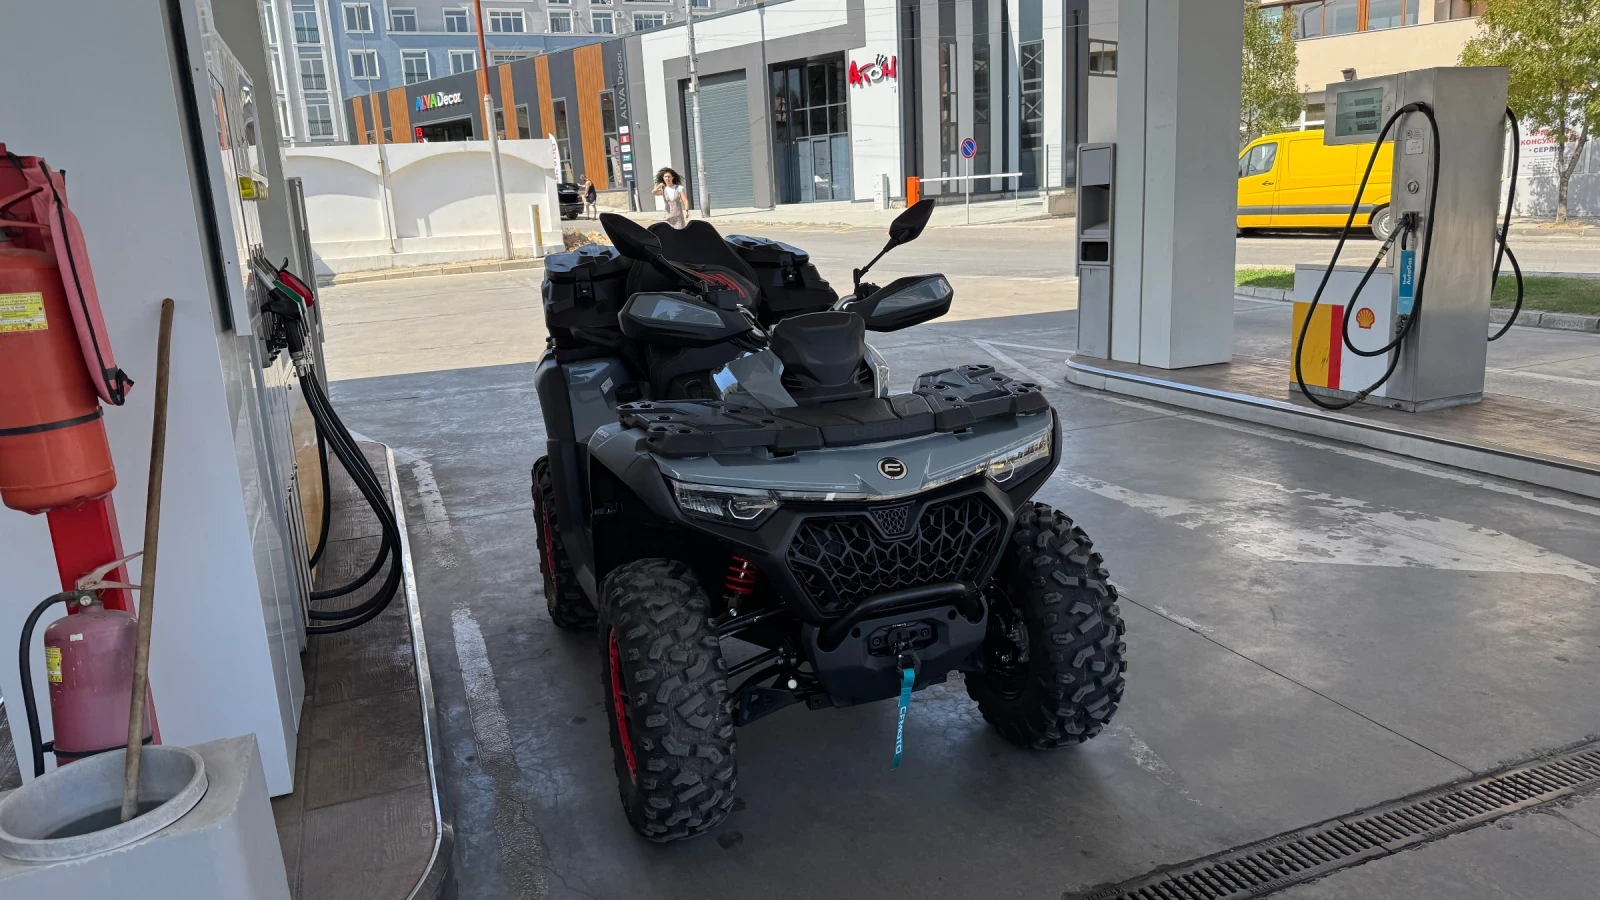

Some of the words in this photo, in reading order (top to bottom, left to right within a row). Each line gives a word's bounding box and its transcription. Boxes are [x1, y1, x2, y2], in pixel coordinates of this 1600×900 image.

[416, 93, 438, 111] ALVA
[617, 88, 628, 120] ALVA
[895, 705, 908, 755] CFMOTO
